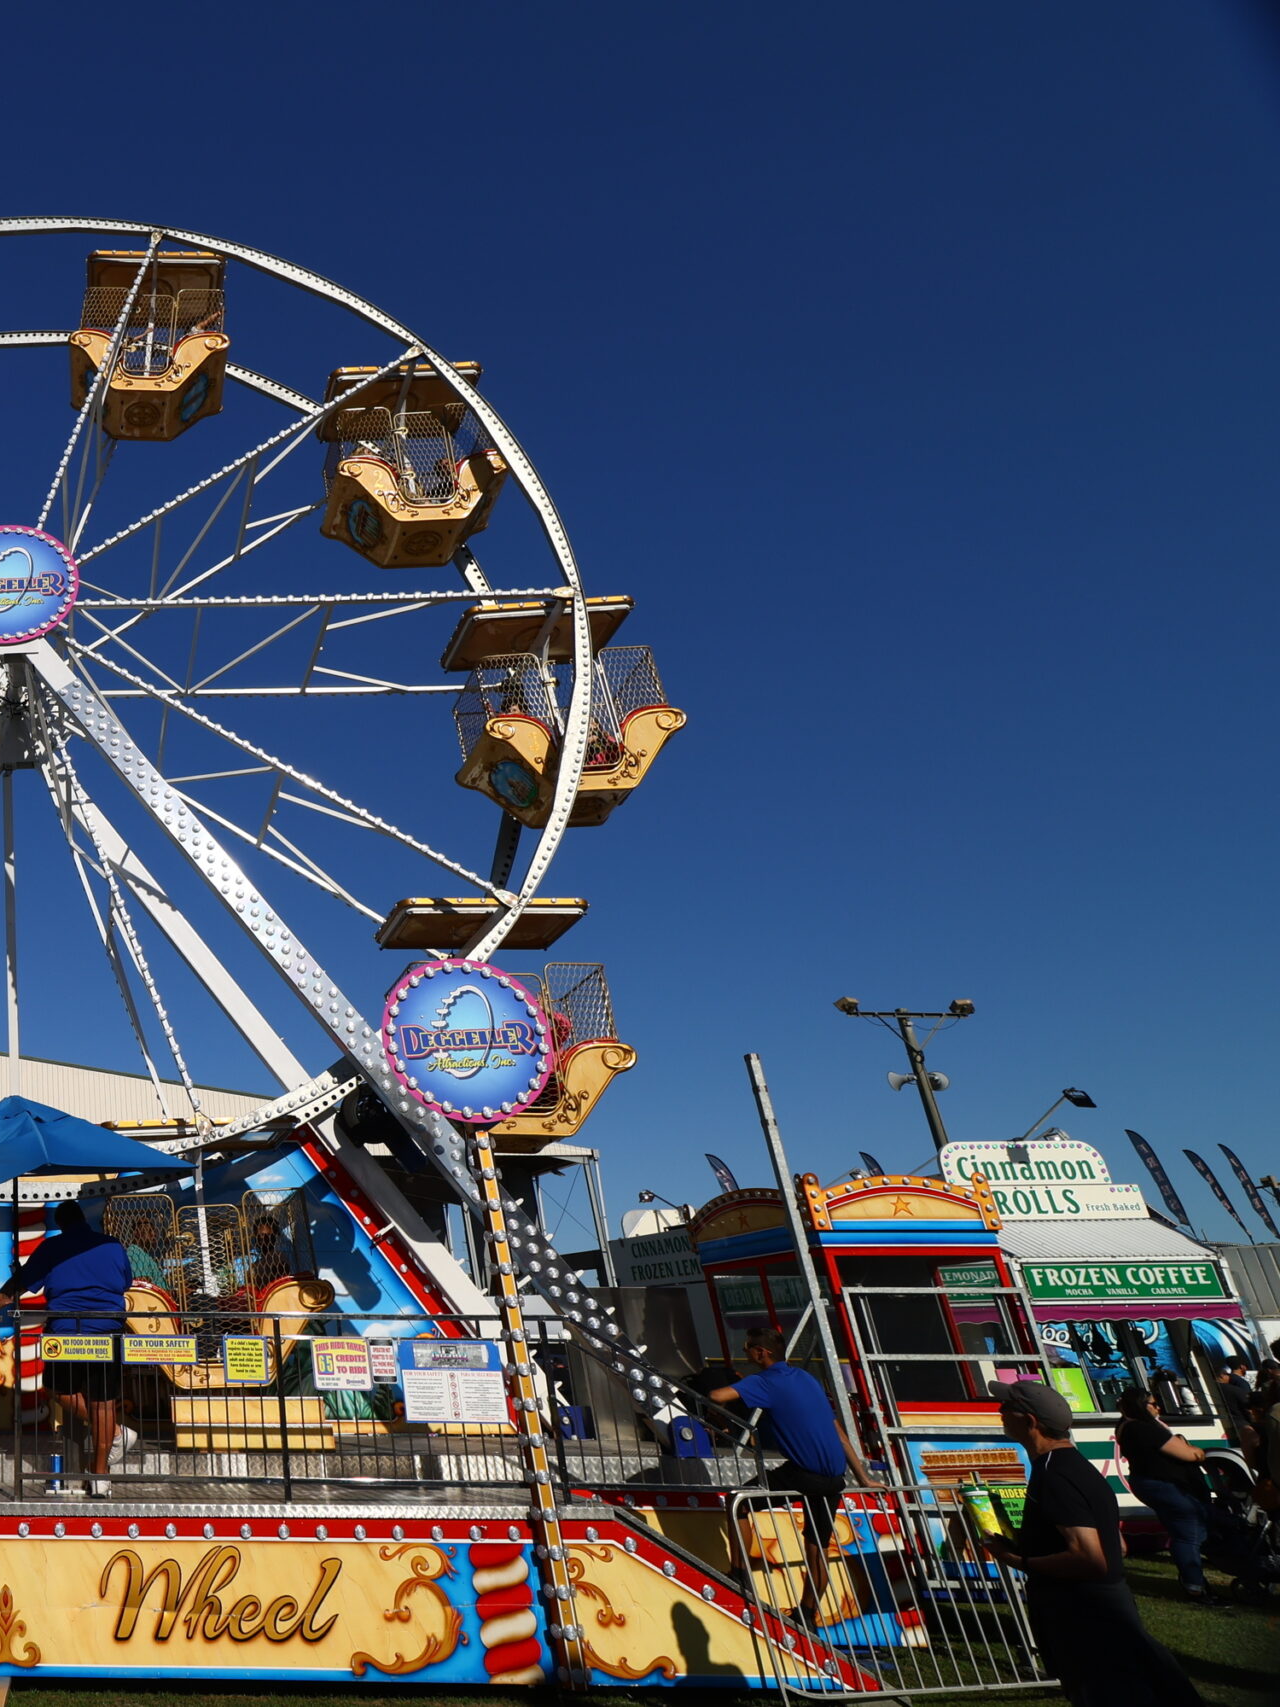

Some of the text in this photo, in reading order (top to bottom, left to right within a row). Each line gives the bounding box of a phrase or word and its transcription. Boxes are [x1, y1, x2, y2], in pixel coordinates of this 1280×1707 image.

[400, 1020, 537, 1059] DEGGELLER
[491, 1055, 516, 1069] Inc.
[956, 1155, 1096, 1182] Cinnamon
[992, 1188, 1141, 1215] ROLLS Fresh Baked
[631, 1236, 690, 1258] CINNAMON
[631, 1261, 674, 1281] FROZEN
[1030, 1266, 1212, 1286] FROZEN COFFEE
[1065, 1287, 1188, 1296] MOCHA VANILLA CARAMEL
[165, 1340, 190, 1348] SAFETY
[315, 1341, 366, 1353] THIS RIDE TAKES
[318, 1354, 333, 1373] 65
[335, 1354, 367, 1362] CREDITS
[337, 1366, 368, 1374] TO RIDE
[99, 1545, 343, 1642] Wheel
